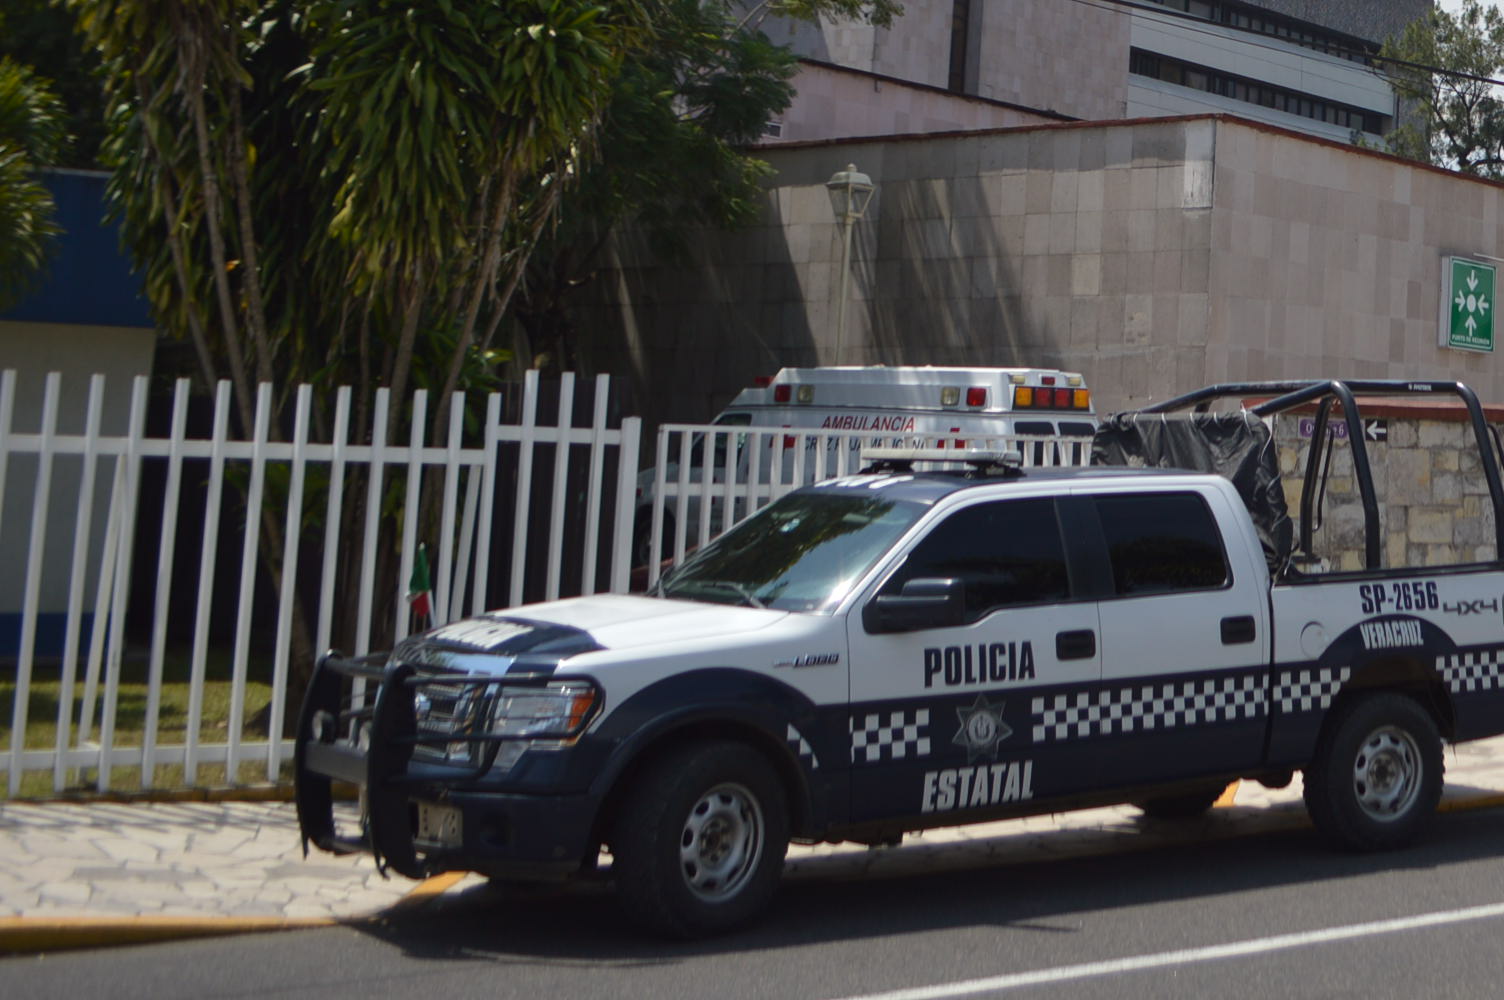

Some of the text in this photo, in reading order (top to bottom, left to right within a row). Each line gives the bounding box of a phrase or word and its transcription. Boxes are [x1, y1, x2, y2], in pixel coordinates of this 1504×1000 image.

[821, 415, 915, 432] AMBULANCIA
[1359, 581, 1439, 614] SP-2656
[1443, 598, 1498, 616] 4X4
[1359, 619, 1424, 650] VERACRUZ
[924, 641, 1035, 688] POLICIA
[921, 759, 1034, 813] ESTATAL
